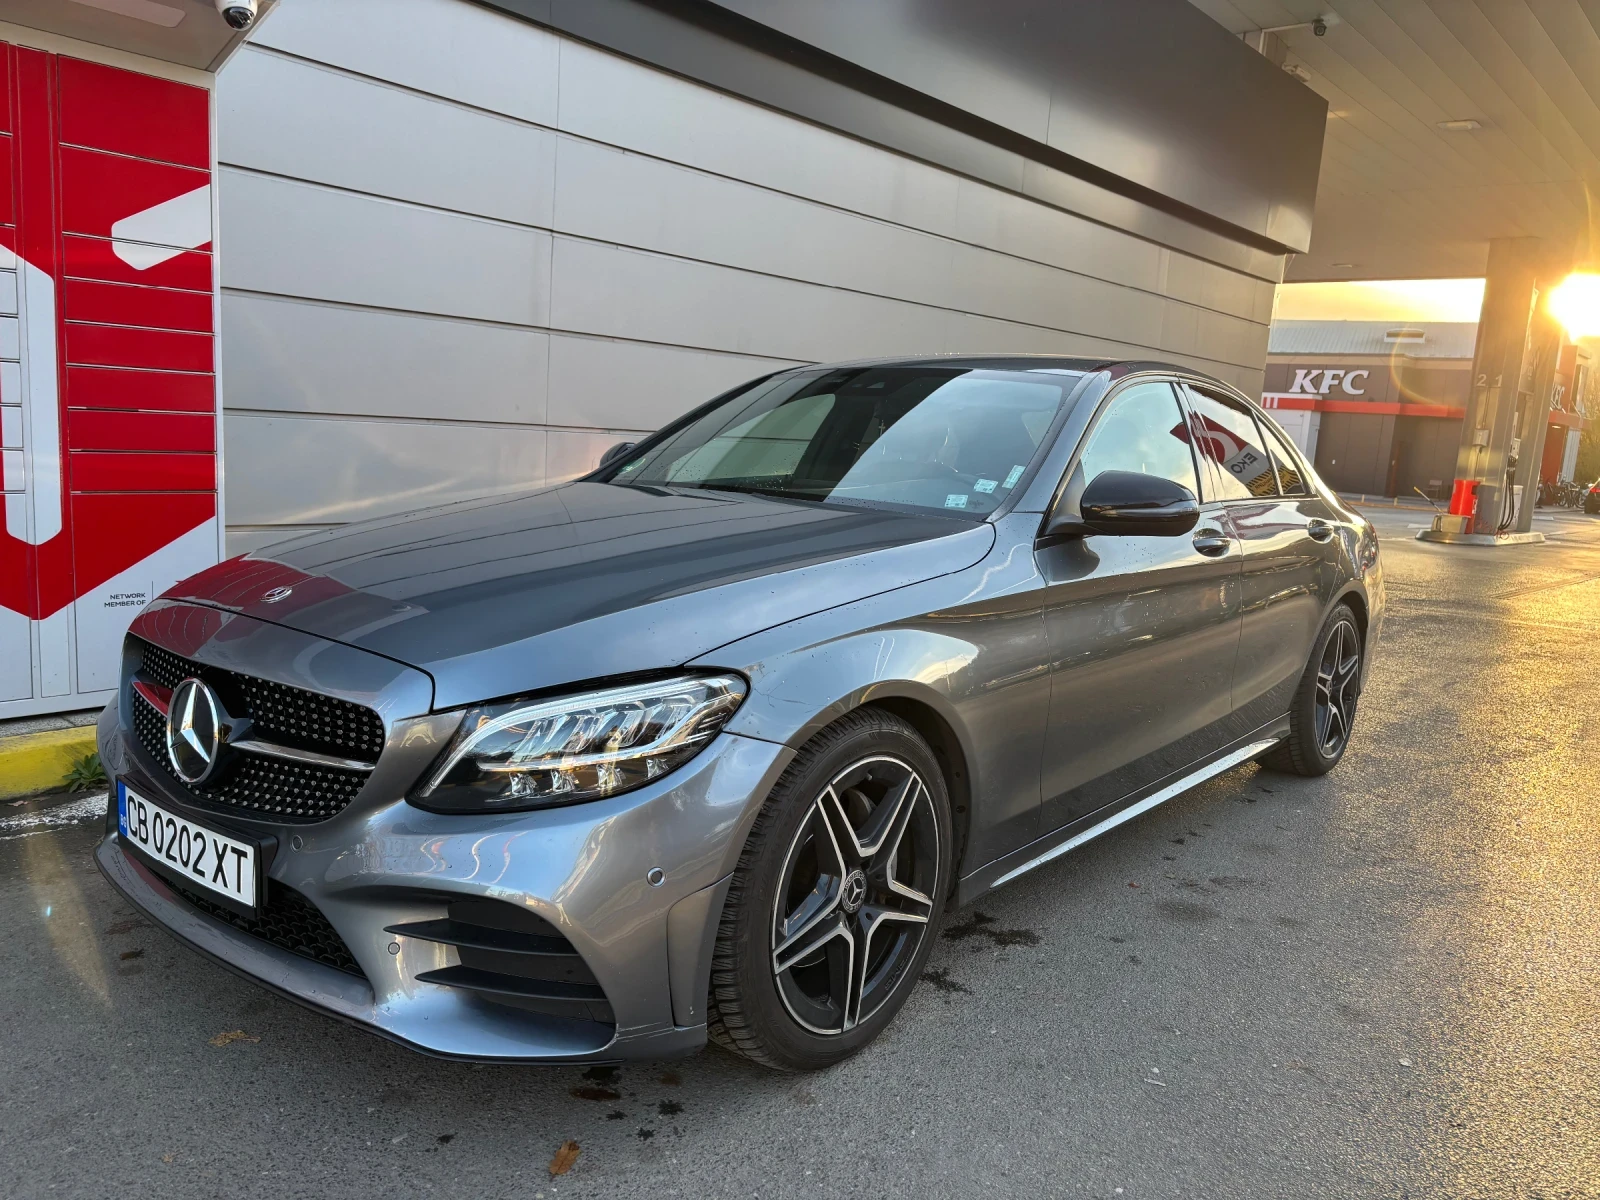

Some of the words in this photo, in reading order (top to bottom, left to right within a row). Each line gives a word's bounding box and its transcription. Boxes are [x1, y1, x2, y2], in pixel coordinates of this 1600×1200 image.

[1288, 369, 1370, 395] KFC
[1476, 373, 1487, 387] 2
[1495, 374, 1503, 388] 1
[109, 592, 146, 600] NETWORK
[104, 600, 136, 608] MEMBER
[127, 795, 149, 845] CB
[153, 811, 207, 878] 0202
[212, 838, 248, 894] XT
